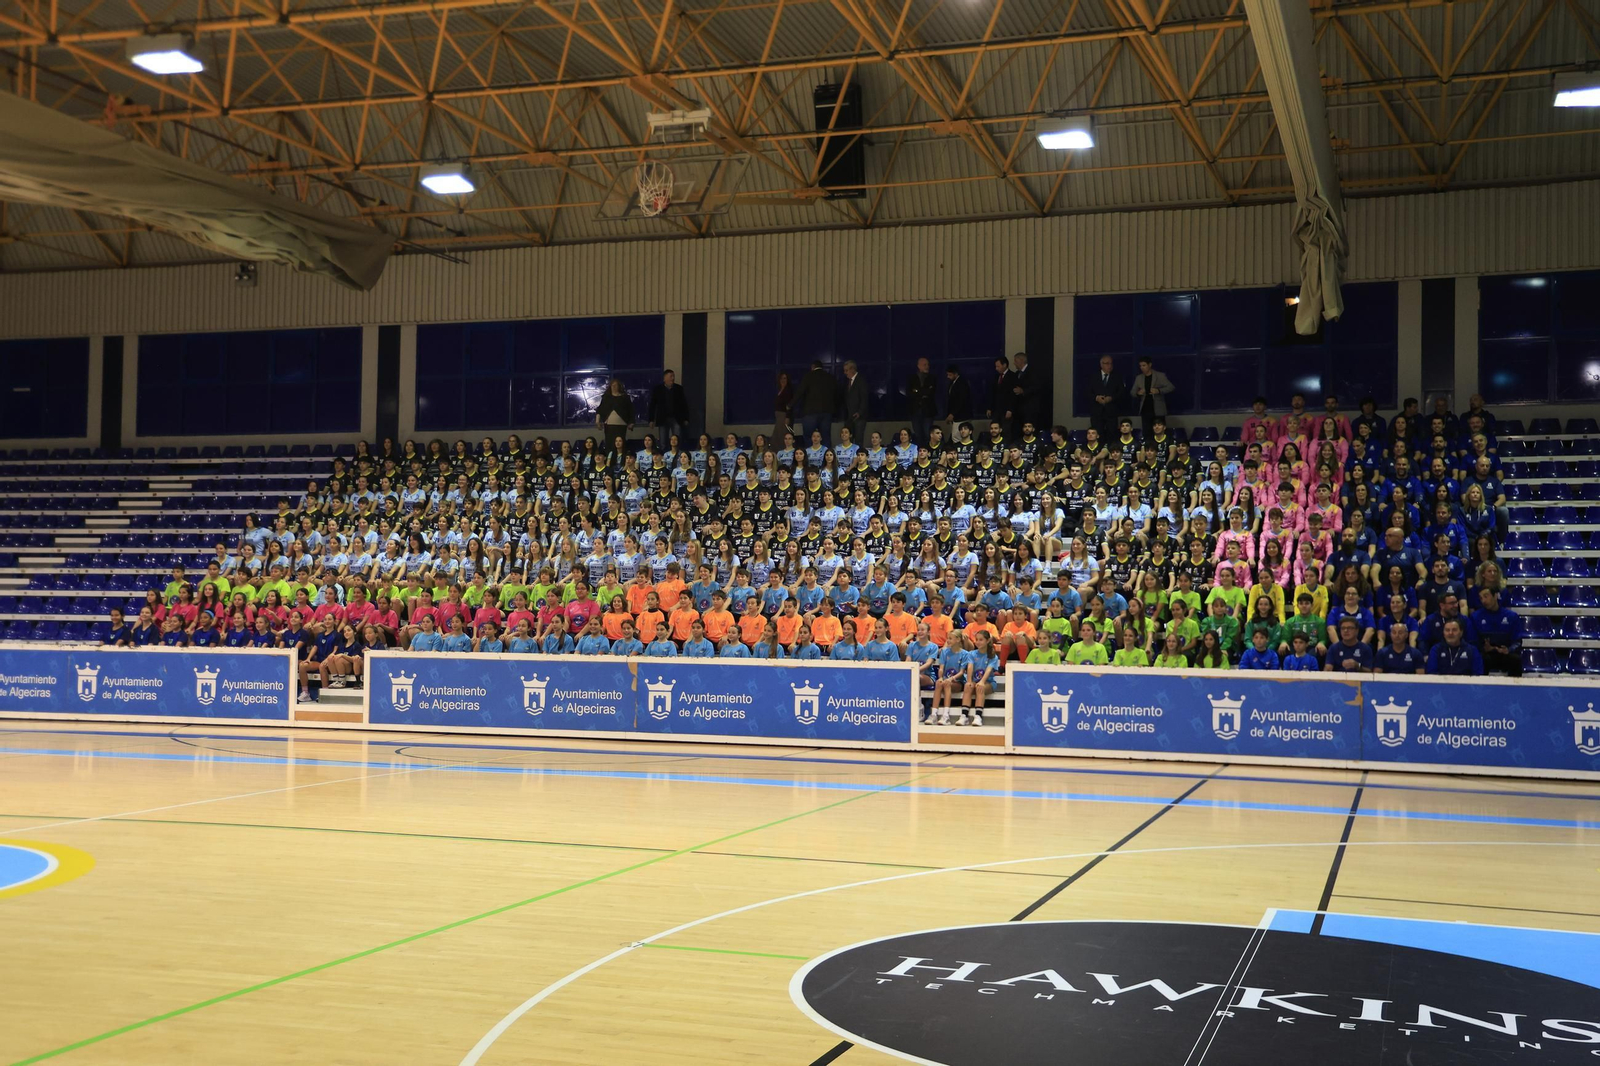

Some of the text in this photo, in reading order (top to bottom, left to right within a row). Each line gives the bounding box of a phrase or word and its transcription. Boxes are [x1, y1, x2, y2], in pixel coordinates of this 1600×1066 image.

[0, 674, 57, 686] Ayuntamiento
[103, 675, 163, 688] Ayuntamiento
[222, 678, 284, 691] Ayuntamiento
[9, 687, 51, 699] Algeciras
[102, 689, 157, 703] de Algeciras
[419, 684, 487, 697] Ayuntamiento
[552, 687, 623, 701] Ayuntamiento
[679, 691, 753, 704] Ayuntamiento
[221, 692, 278, 706] de Algeciras
[419, 698, 480, 713] de Algeciras
[827, 695, 905, 710] Ayuntamiento
[552, 702, 616, 717] de Algeciras
[678, 705, 746, 719] de Algeciras
[1077, 702, 1163, 717] Ayuntamiento
[1250, 708, 1342, 724] Ayuntamiento
[826, 710, 898, 726] de Algeciras
[1417, 714, 1516, 730] Ayuntamiento
[1076, 718, 1155, 735] de Algeciras
[1250, 725, 1334, 742] de Algeciras
[1417, 731, 1507, 748] de Algeciras
[876, 955, 1600, 1044] HAWKINS
